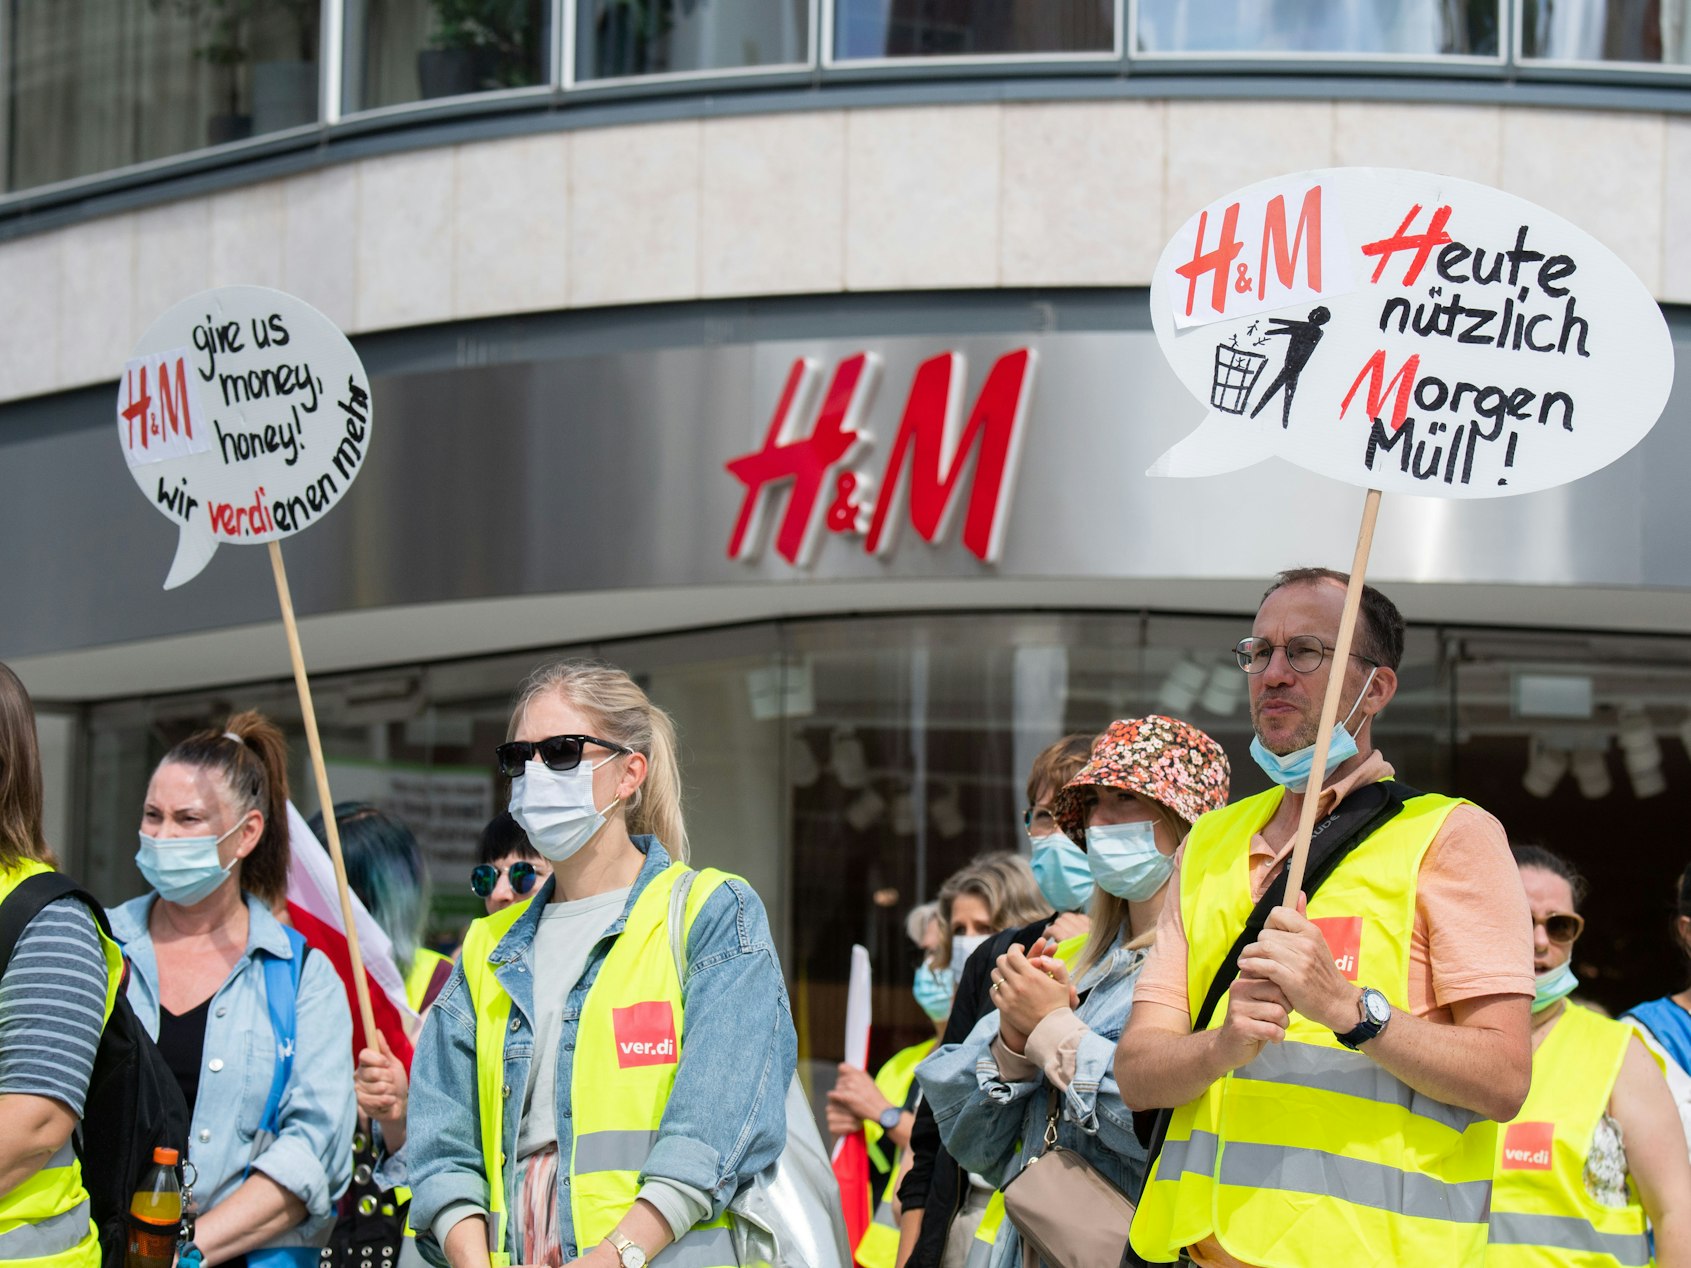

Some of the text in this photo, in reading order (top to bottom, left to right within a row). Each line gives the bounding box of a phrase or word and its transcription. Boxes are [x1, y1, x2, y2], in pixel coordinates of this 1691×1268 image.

[1176, 185, 1322, 316] H&M
[1361, 203, 1577, 298] Heute
[252, 313, 290, 350] us
[1379, 285, 1590, 358] nützlich
[122, 356, 192, 450] H&M
[219, 362, 323, 413] money,
[1340, 349, 1574, 441] Morgen
[158, 477, 198, 522] wir
[332, 374, 369, 480] mehr
[214, 405, 305, 466] honey!
[724, 347, 1034, 564] H&M
[620, 1038, 673, 1056] ver.di
[1505, 1149, 1549, 1165] ver.di
